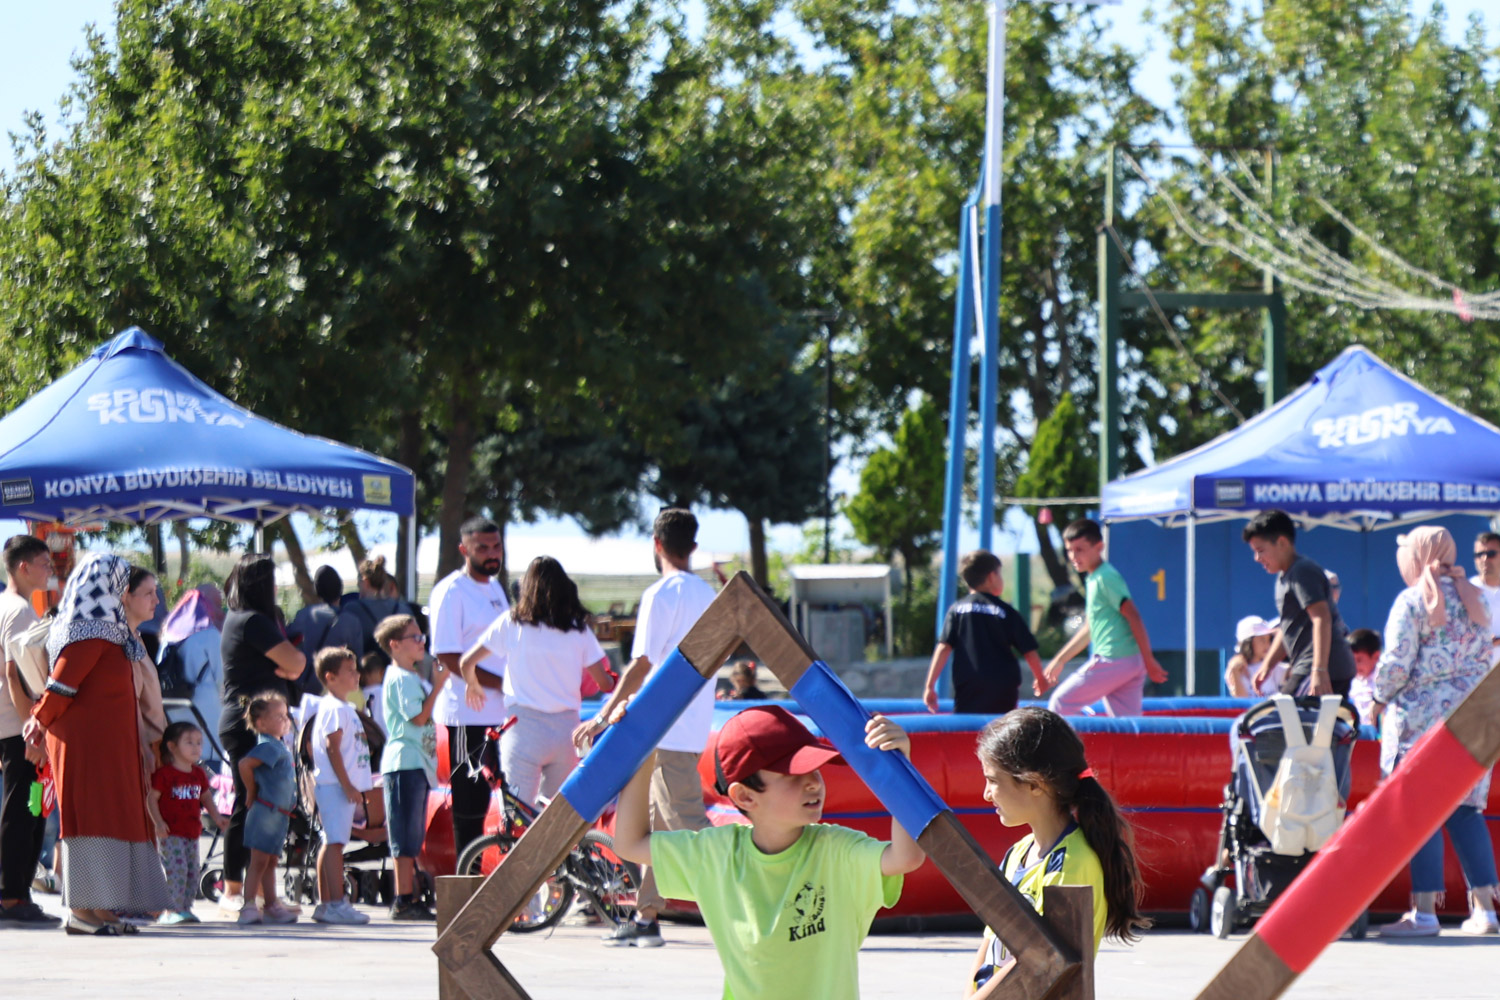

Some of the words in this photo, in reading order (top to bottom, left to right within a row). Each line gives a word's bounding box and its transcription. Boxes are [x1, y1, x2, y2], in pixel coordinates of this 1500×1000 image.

[99, 399, 245, 429] KONYA
[1317, 416, 1457, 449] KONYA
[44, 472, 121, 499] KONYA
[1253, 482, 1323, 502] KONYA
[1150, 568, 1166, 601] 1
[789, 917, 826, 942] Kind
